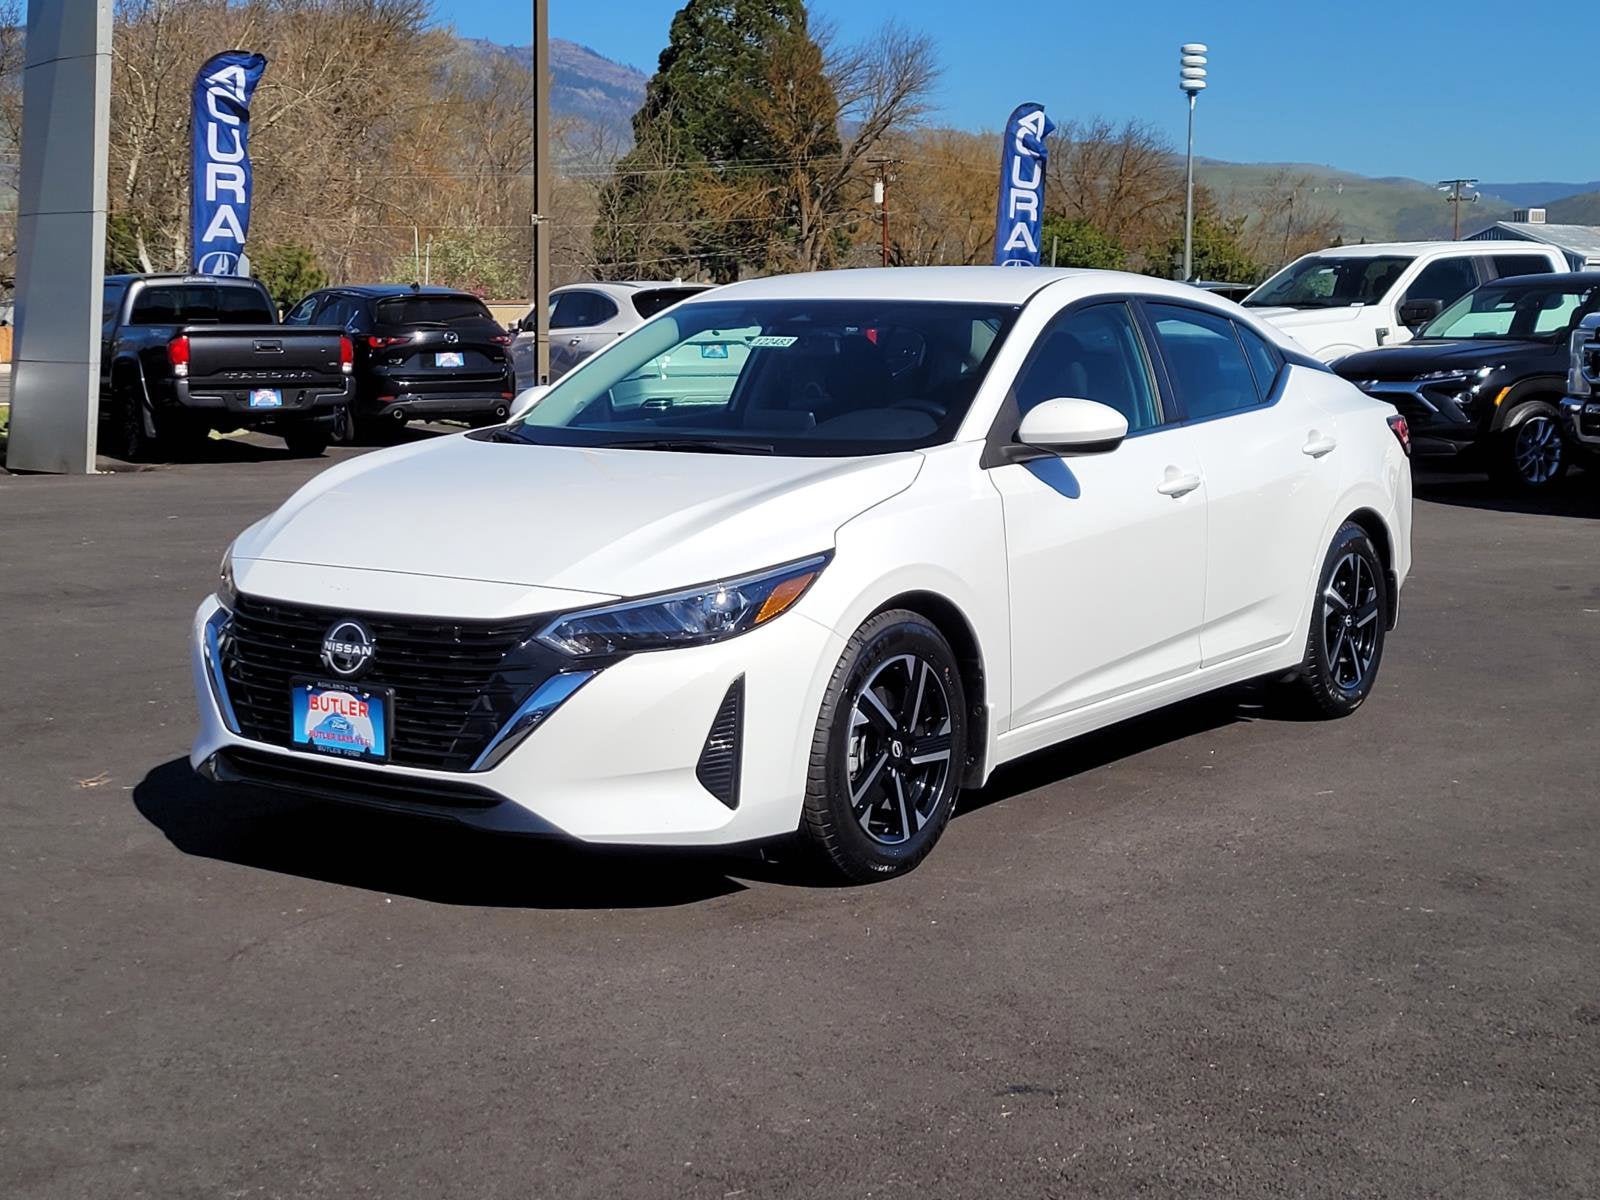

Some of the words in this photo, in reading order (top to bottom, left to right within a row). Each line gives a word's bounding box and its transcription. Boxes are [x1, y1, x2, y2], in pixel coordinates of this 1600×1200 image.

[202, 65, 246, 243] ACURA
[1003, 110, 1045, 253] ACURA
[323, 641, 372, 656] NISSAN
[309, 695, 368, 717] BUTLER
[318, 745, 342, 754] BUTLER
